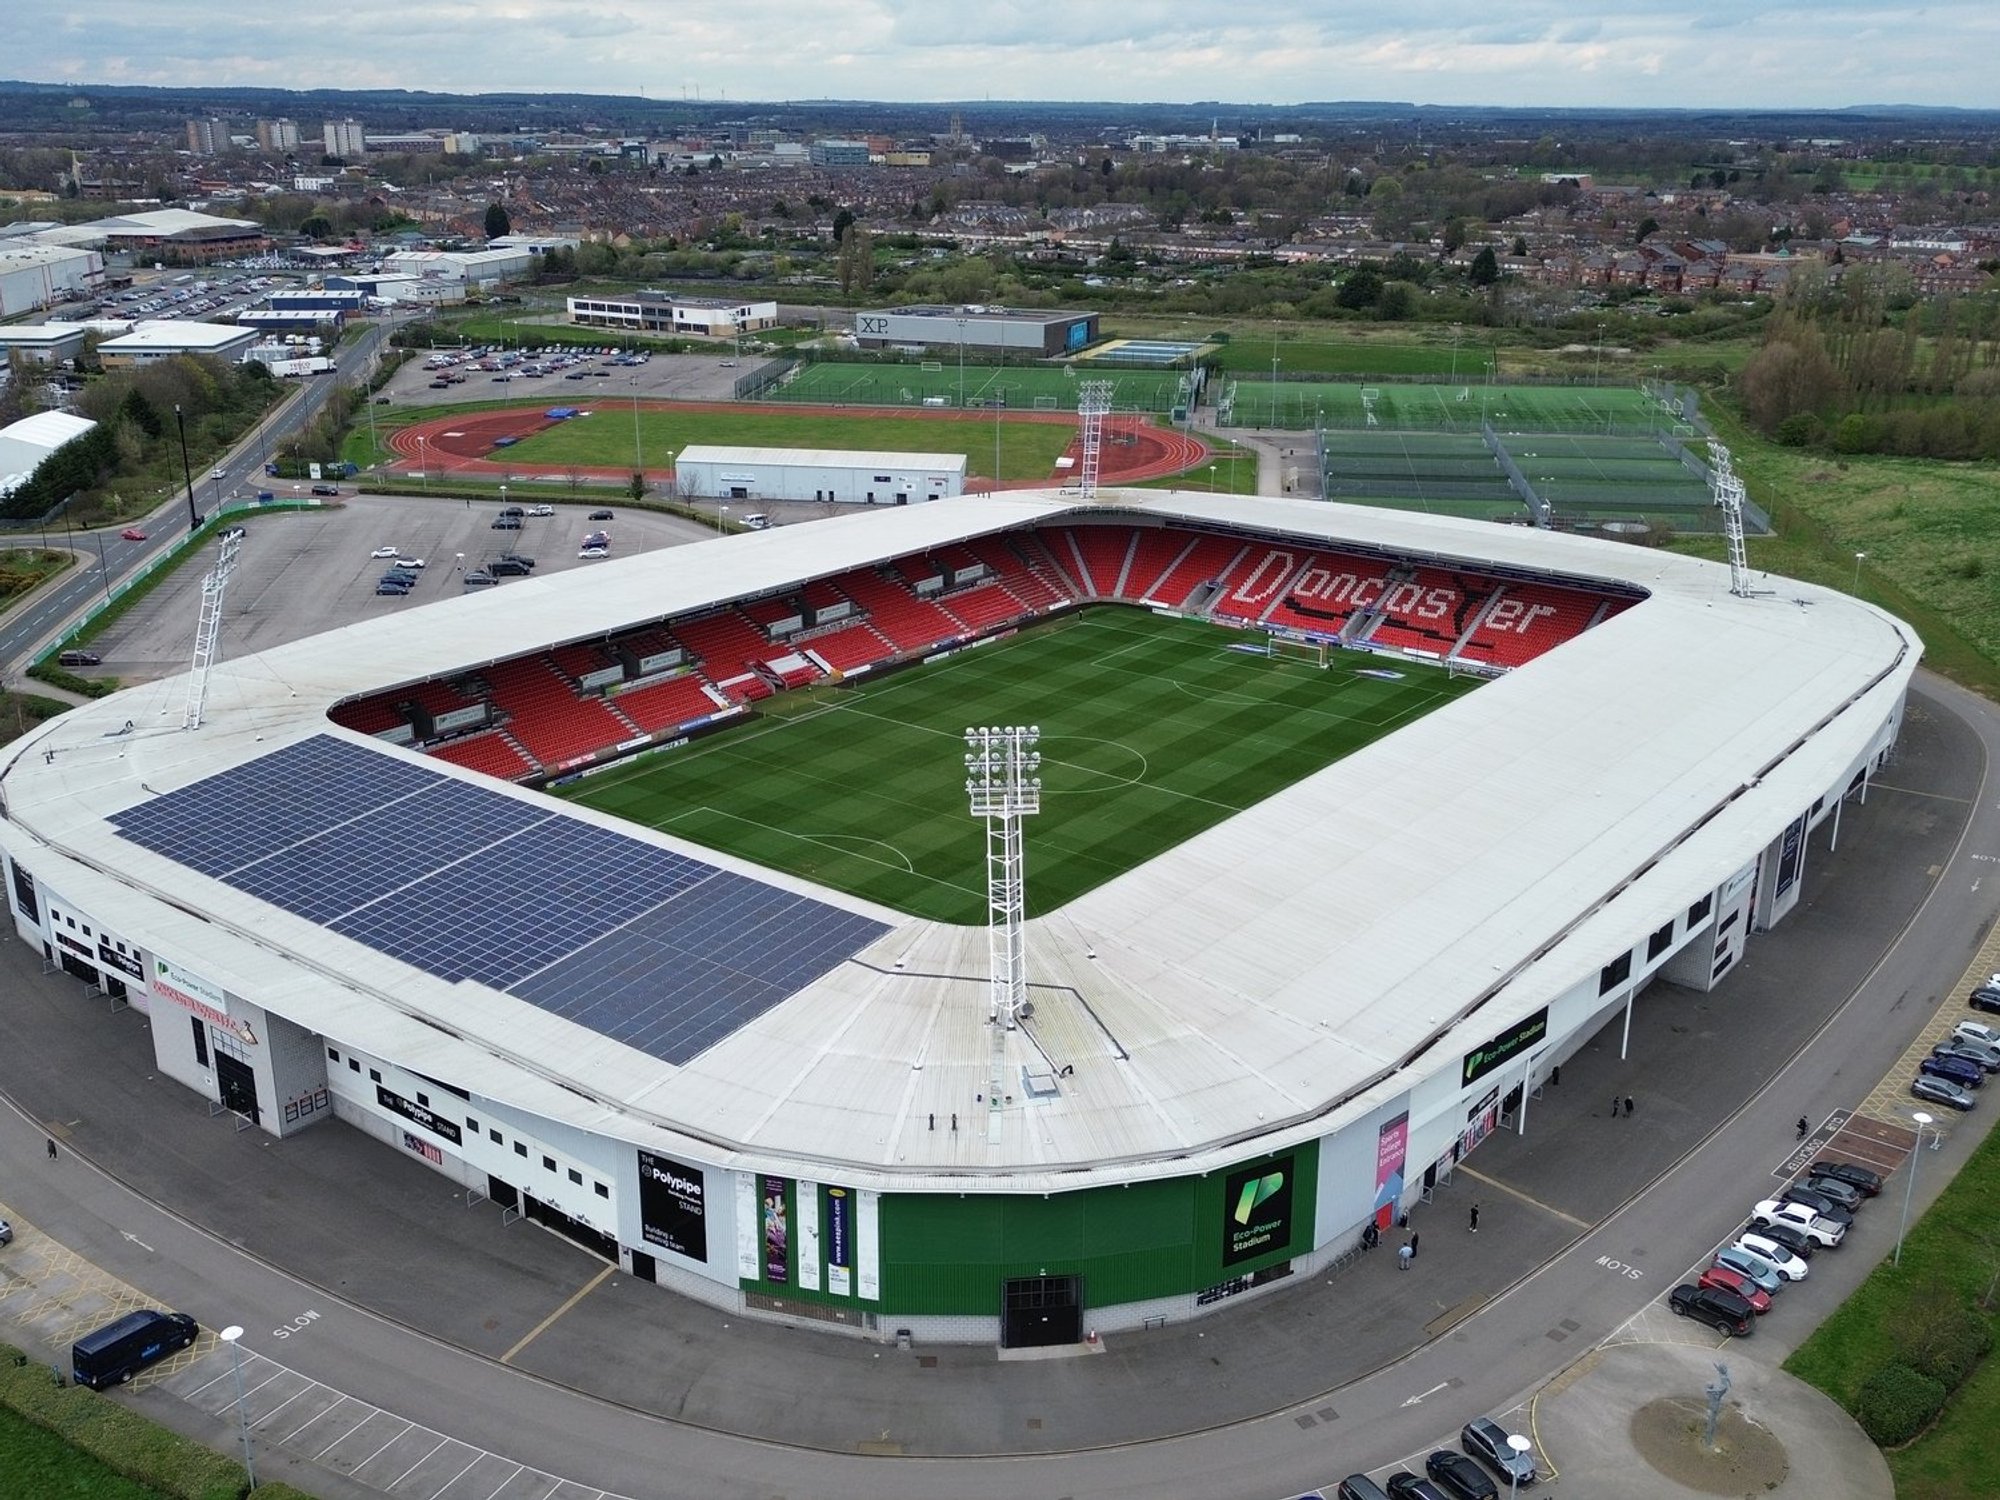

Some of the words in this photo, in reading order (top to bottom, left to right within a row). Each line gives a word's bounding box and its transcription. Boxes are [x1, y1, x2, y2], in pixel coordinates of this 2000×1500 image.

[403, 1100, 433, 1123] Polypipe
[641, 1154, 655, 1167] THE
[653, 1167, 702, 1195] Polypipe
[679, 1201, 702, 1216] STAND
[1233, 1219, 1283, 1242] Eco-Power
[1233, 1233, 1271, 1252] Stadium
[1595, 1255, 1644, 1280] SLOW
[273, 1309, 321, 1339] SLOW
